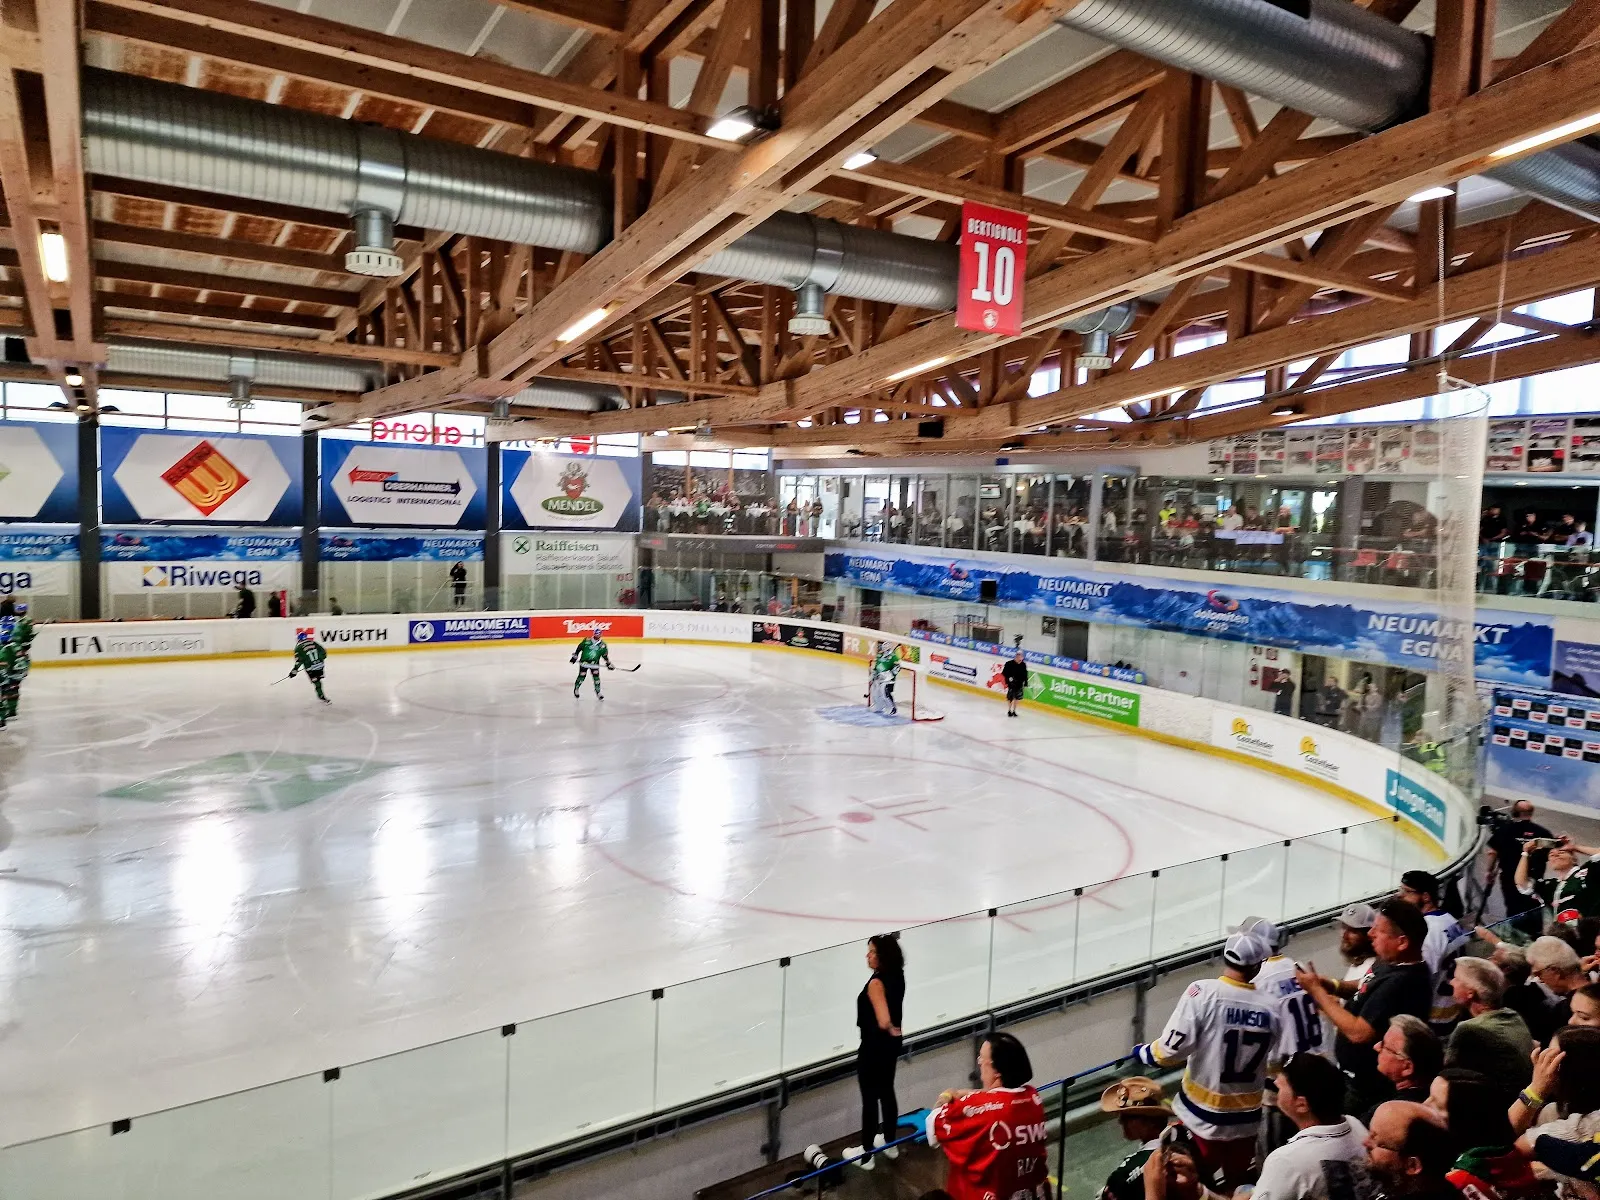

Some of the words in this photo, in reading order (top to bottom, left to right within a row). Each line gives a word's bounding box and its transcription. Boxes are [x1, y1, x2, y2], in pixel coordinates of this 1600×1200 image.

[971, 241, 1016, 306] 10
[396, 497, 463, 506] INTERNATIONAL
[547, 499, 599, 513] MENDEL
[226, 537, 297, 548] NEUMARKT
[422, 539, 482, 549] NEUMARKT
[535, 539, 600, 551] Raiffeisen
[438, 548, 466, 557] EGNA
[849, 557, 895, 572] NEUMARKT
[170, 565, 262, 590] Riwega
[859, 571, 882, 583] EGNA
[1037, 577, 1113, 598] NEUMARKT
[1055, 595, 1090, 611] EGNA
[445, 618, 527, 632] MANOMETAL
[562, 619, 613, 634] Loacker
[60, 635, 104, 654] IFA
[1400, 638, 1464, 662] EGNA
[1049, 679, 1077, 696] Jahn
[1087, 686, 1136, 710] Partner
[1226, 1007, 1271, 1029] HANSON
[1164, 1028, 1187, 1051] 17
[1219, 1029, 1274, 1085] 17
[1015, 1121, 1048, 1146] SW
